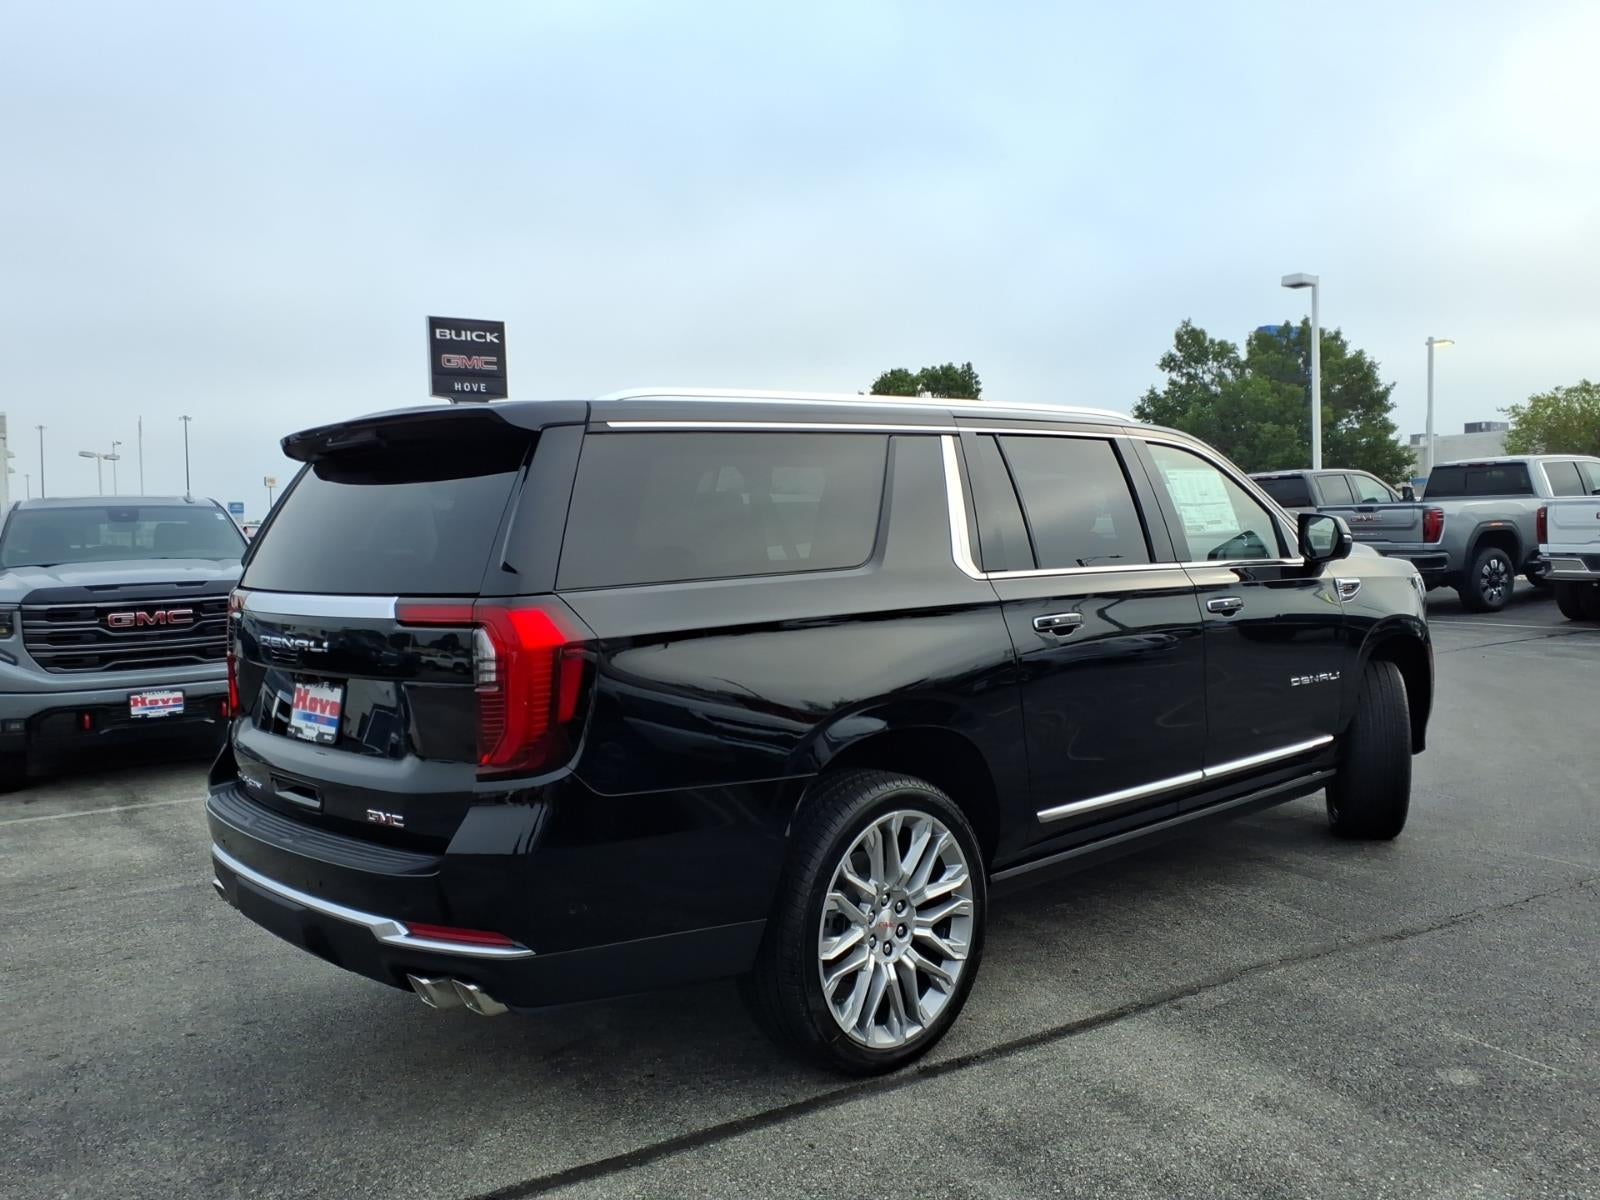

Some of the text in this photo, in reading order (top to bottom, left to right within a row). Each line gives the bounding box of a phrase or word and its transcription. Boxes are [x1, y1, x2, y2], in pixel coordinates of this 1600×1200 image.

[435, 328, 499, 343] BUICK
[441, 354, 498, 370] GMC
[454, 382, 487, 392] HOVE
[107, 609, 194, 628] GMC
[1290, 671, 1340, 687] DENALI
[366, 809, 405, 828] GMC
